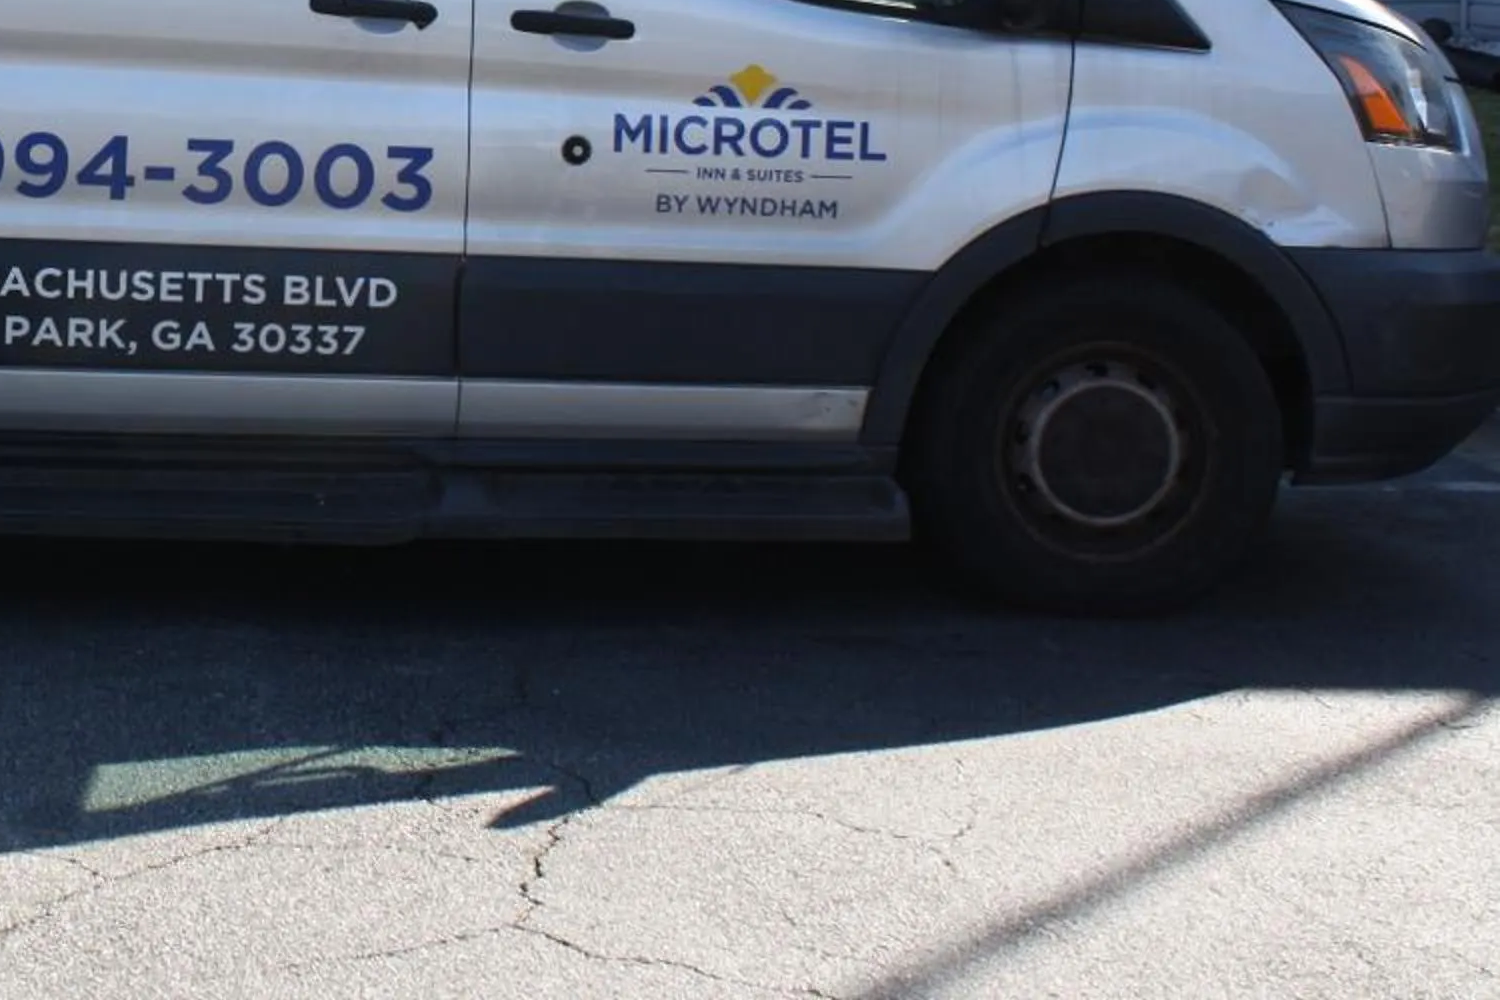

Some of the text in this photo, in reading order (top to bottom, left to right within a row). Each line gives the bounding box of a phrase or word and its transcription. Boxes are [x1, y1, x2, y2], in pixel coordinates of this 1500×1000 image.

[613, 113, 887, 161] MICROTEL
[697, 166, 804, 183] INN & SUITES
[656, 194, 838, 219] BY WYNDHAM
[283, 275, 398, 308] BLVD
[4, 316, 138, 354] PARK,
[151, 320, 216, 351] GA
[231, 322, 365, 355] 30337
